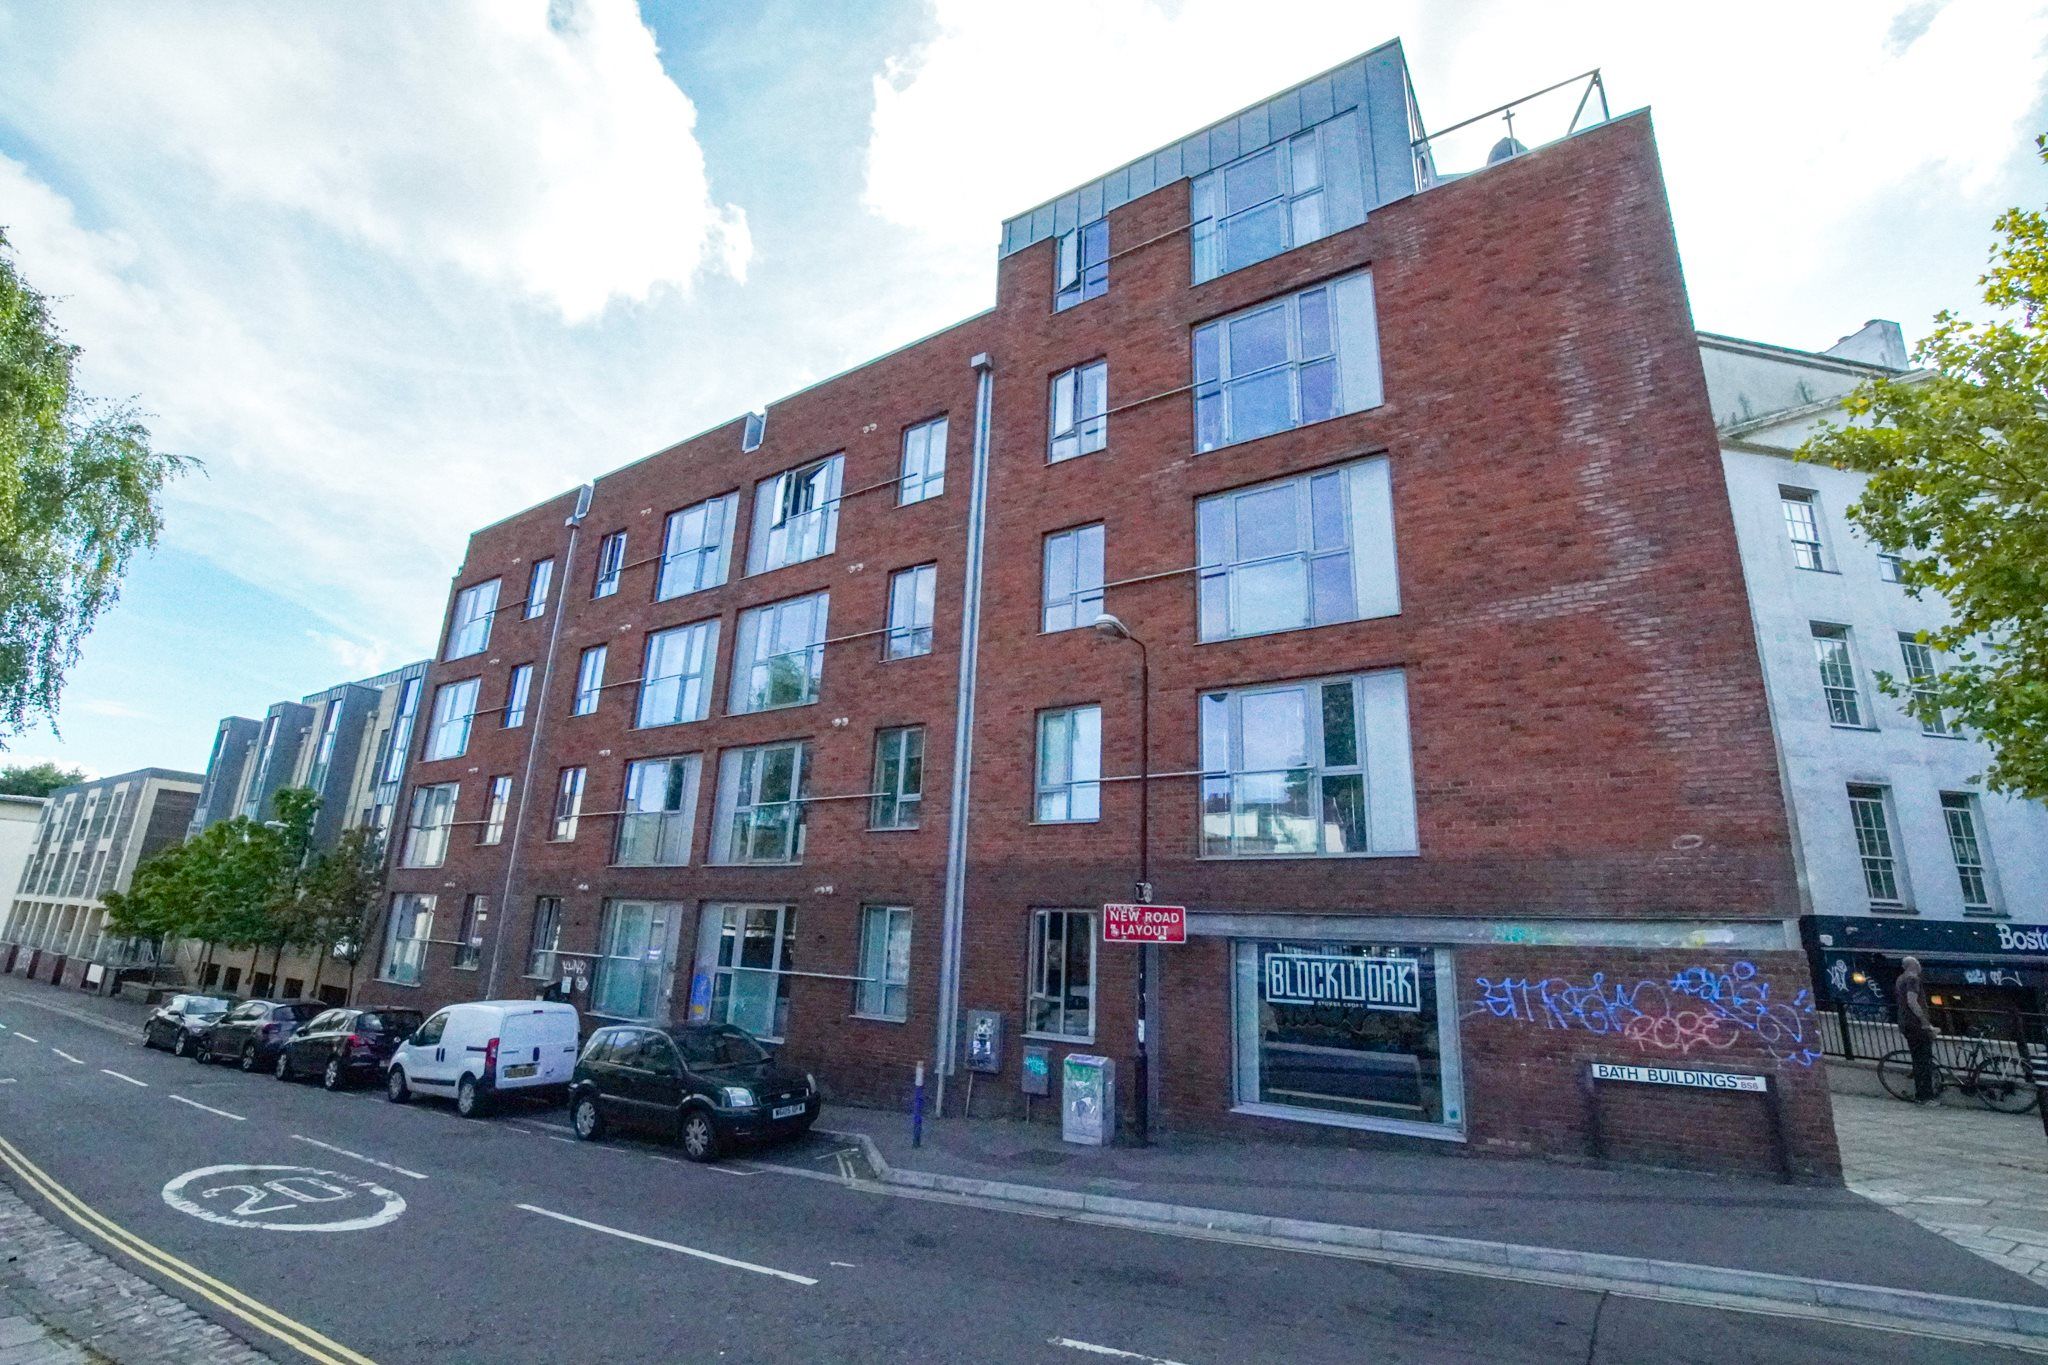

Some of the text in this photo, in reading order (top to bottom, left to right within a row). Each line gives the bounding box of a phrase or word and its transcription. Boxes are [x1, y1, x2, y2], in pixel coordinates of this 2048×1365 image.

[1110, 910, 1179, 923] NEW ROAD
[1121, 925, 1169, 936] LAYOUT
[1271, 960, 1413, 1004] BLOCKWORK
[1599, 1066, 1639, 1080] BATH
[1648, 1069, 1738, 1089] BUILDINGS
[202, 1176, 357, 1217] 20
